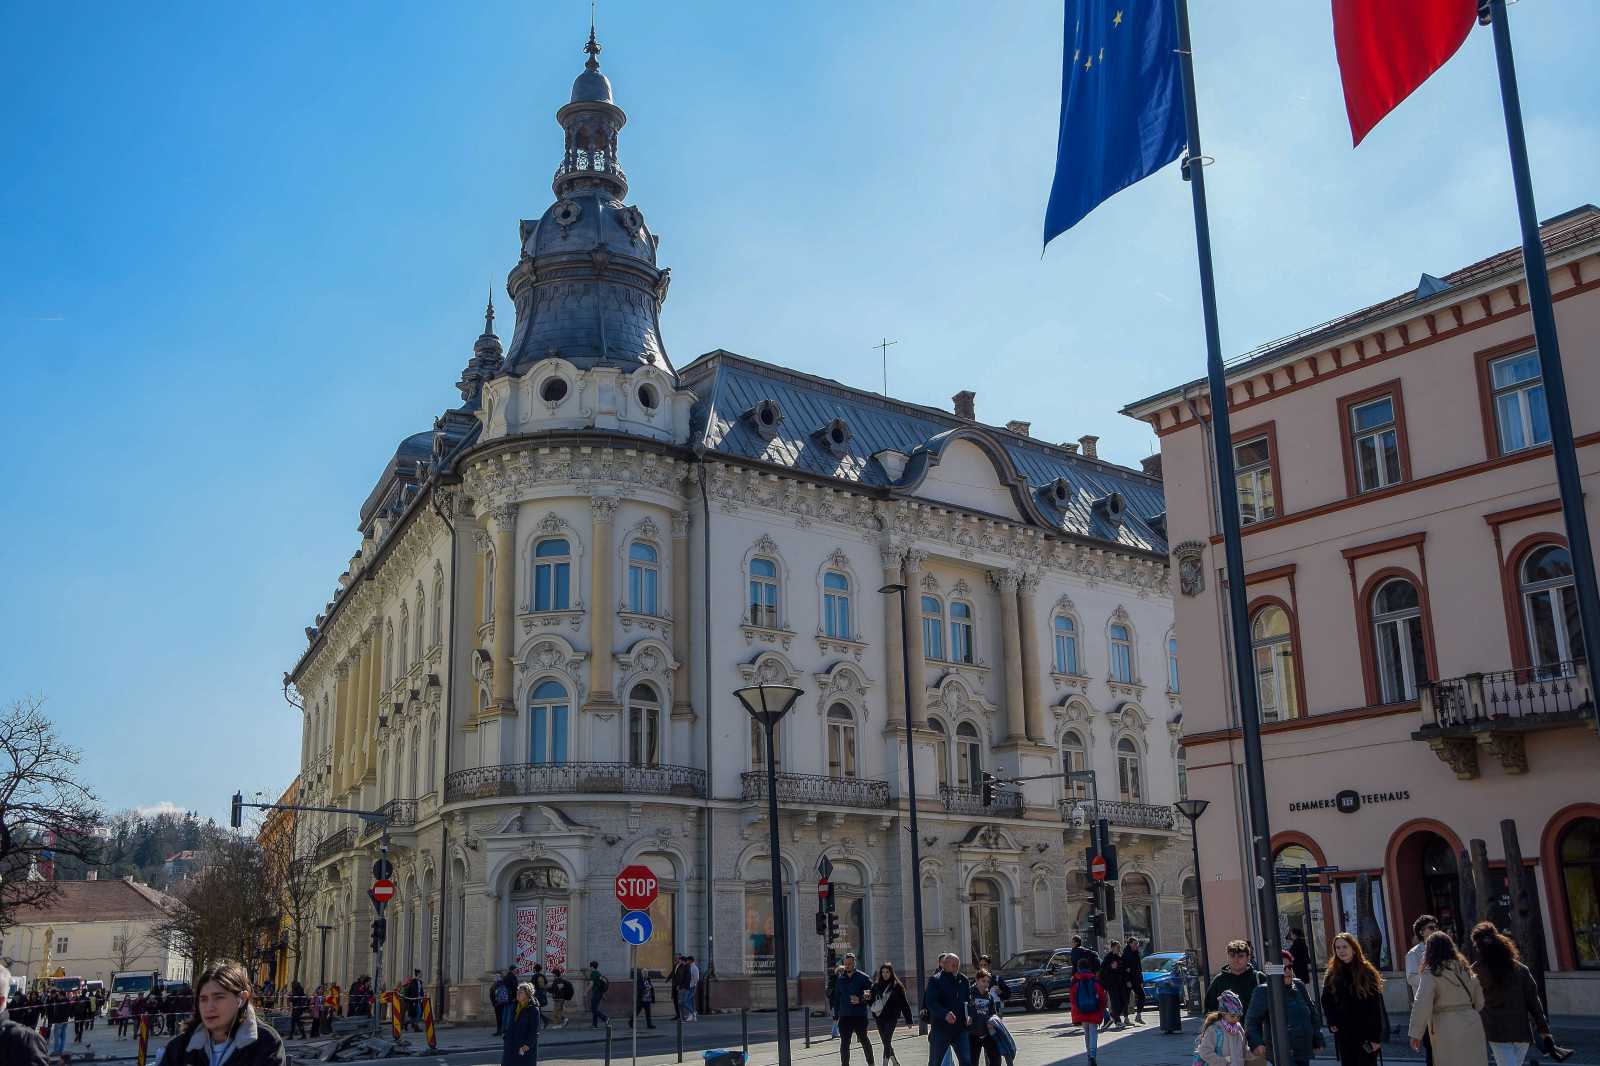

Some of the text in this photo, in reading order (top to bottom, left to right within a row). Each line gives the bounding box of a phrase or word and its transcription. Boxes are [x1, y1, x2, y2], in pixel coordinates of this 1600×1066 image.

[1289, 790, 1410, 812] DEMMERS TEEHAUS
[617, 878, 656, 897] STOP
